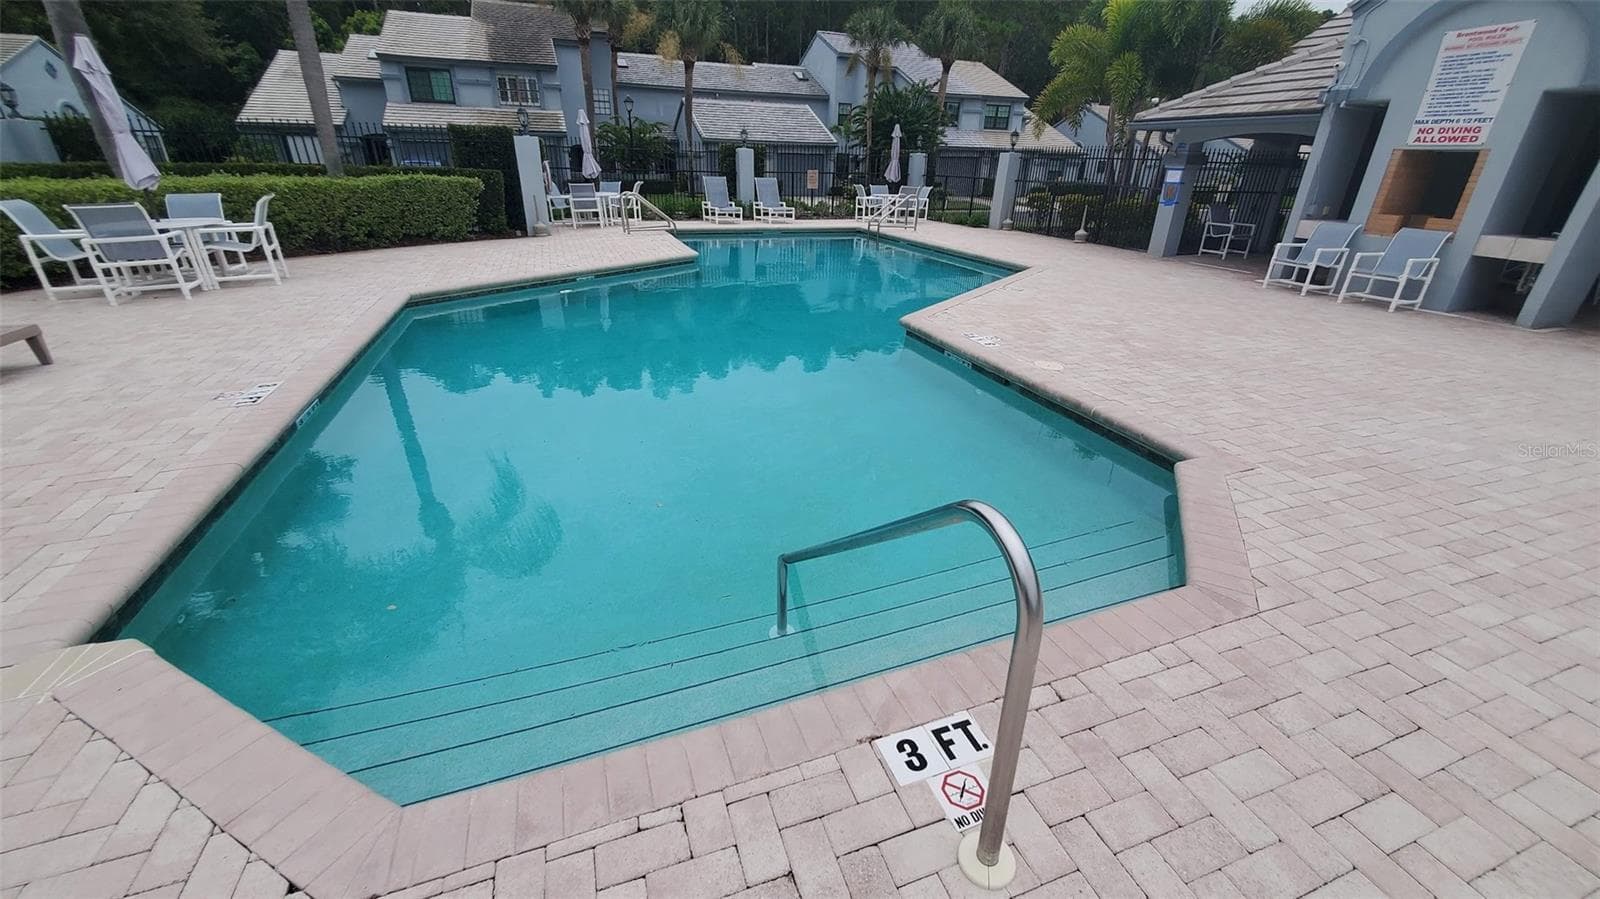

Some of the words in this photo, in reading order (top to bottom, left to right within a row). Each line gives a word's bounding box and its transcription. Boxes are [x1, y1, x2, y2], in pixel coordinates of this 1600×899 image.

[1417, 127, 1434, 135] NO
[1437, 126, 1482, 135] DIVING
[1412, 135, 1479, 143] ALLOWED
[896, 739, 928, 772] 3
[931, 719, 989, 761] FT.
[954, 815, 971, 829] NO
